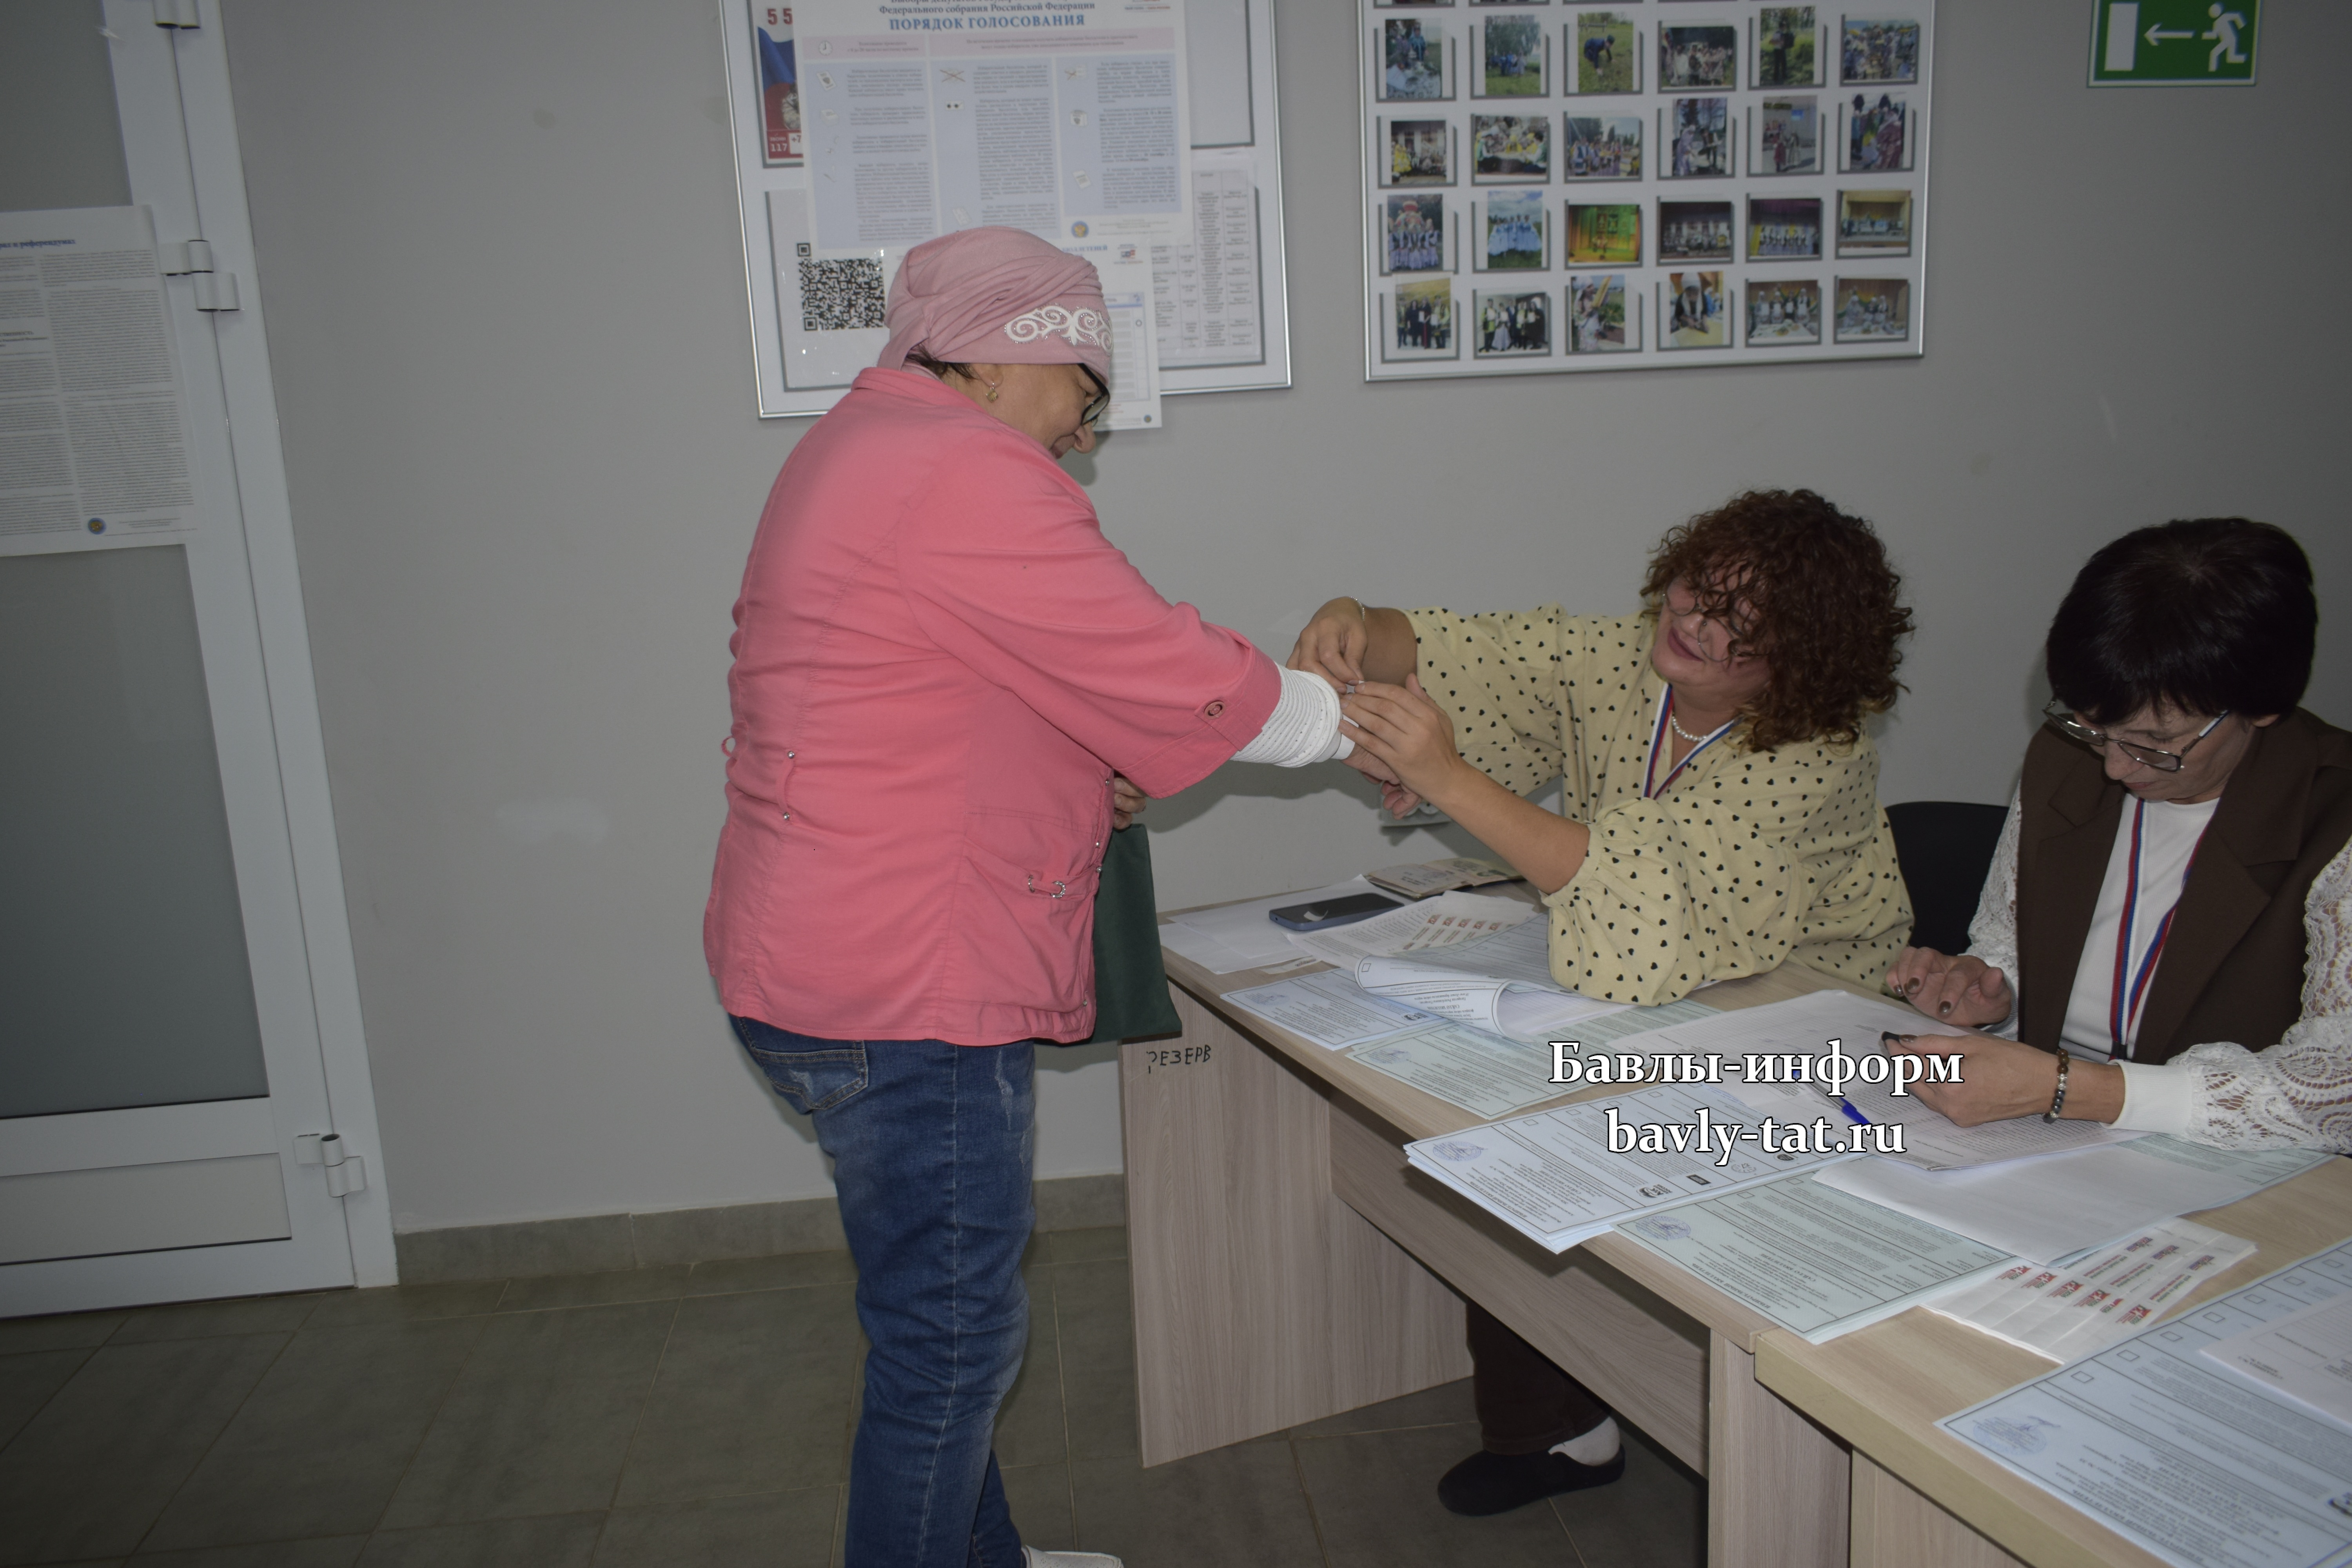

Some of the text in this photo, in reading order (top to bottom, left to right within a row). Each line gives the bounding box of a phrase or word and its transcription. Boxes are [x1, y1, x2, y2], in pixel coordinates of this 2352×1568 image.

[879, 6, 944, 16] Федерального
[946, 5, 988, 15] собрания
[990, 3, 1042, 12] Российской
[1045, 2, 1095, 12] Федерации
[768, 8, 793, 25] 5 5
[889, 14, 1085, 31] ПОРЯДОК ГОЛОСОВАНИЯ
[771, 143, 788, 152] 117
[20, 240, 76, 249] референдумах
